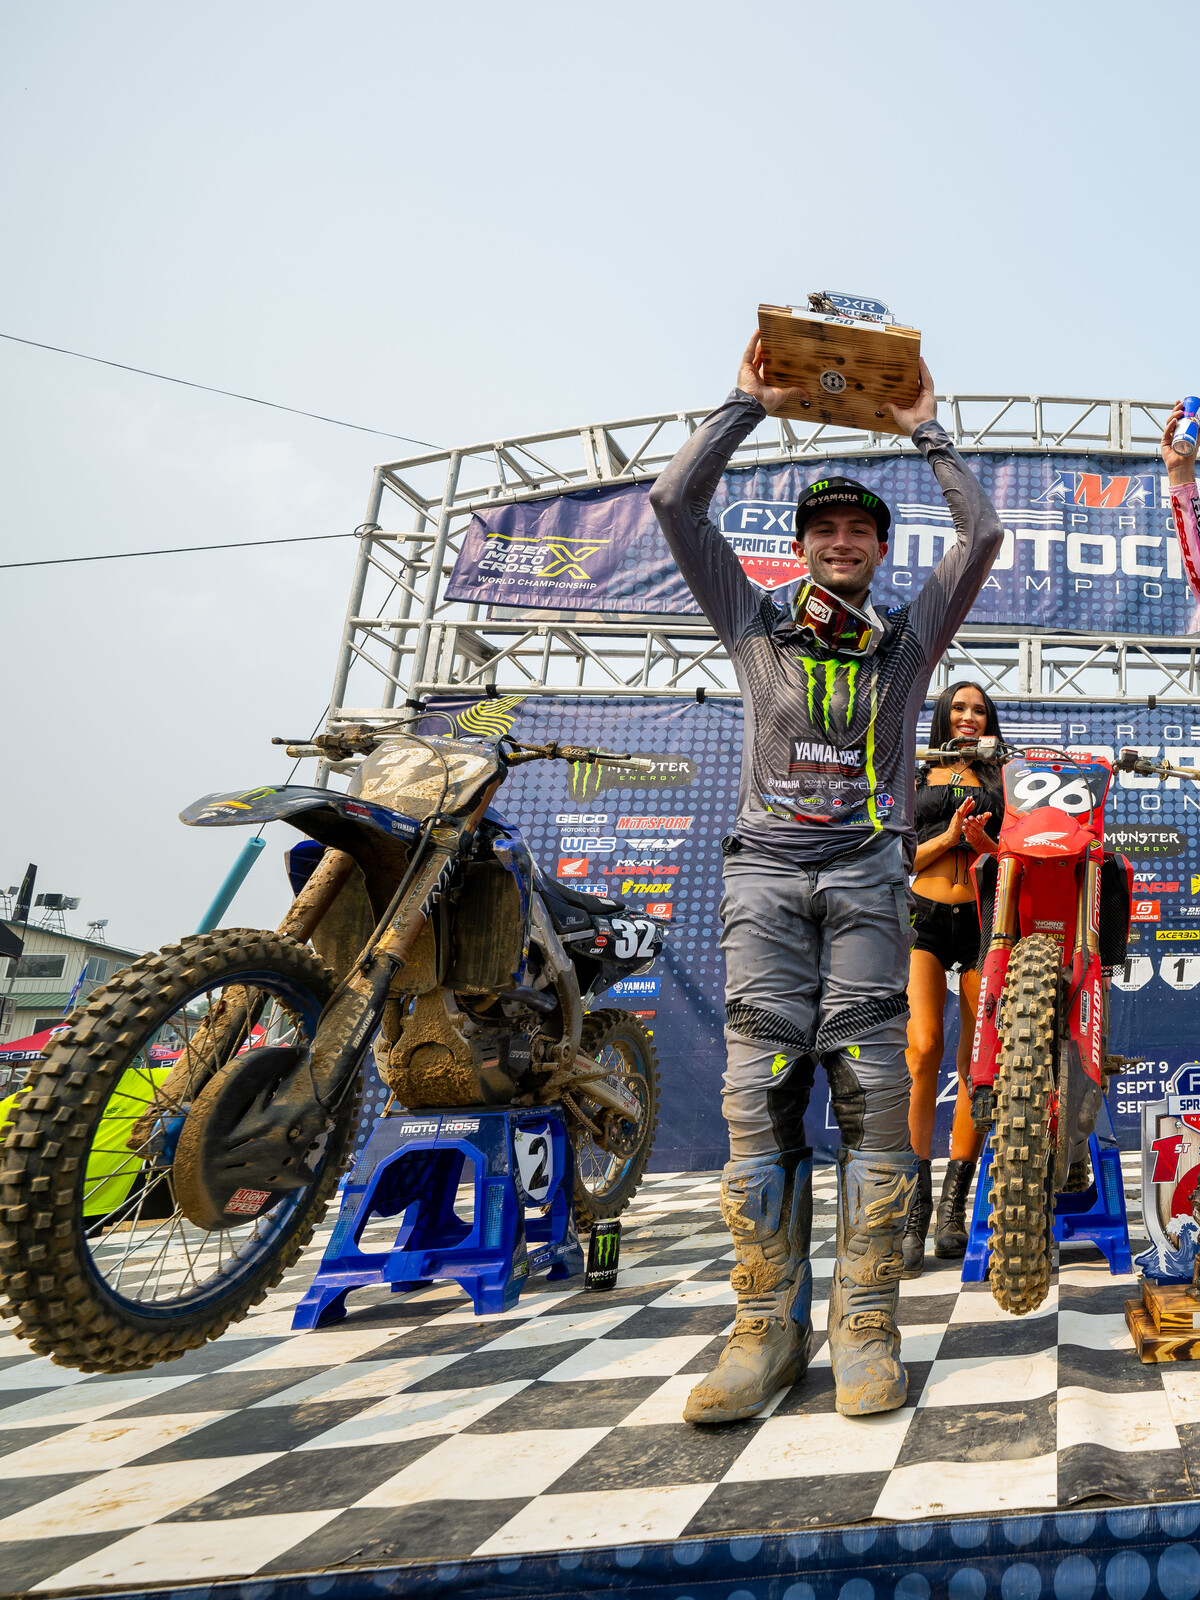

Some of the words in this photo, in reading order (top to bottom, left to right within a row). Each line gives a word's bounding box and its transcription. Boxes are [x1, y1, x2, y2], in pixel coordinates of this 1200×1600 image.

[824, 316, 855, 326] 250
[817, 493, 858, 501] YAMAHA
[1031, 471, 1156, 509] AMA
[741, 508, 796, 532] FX
[483, 540, 551, 555] SUPER
[484, 550, 545, 565] MOTO
[477, 559, 545, 575] CROSS
[477, 575, 515, 585] WORLD
[517, 578, 597, 590] CHAMPIONSHIP
[808, 600, 829, 618] 100%
[1069, 725, 1182, 741] PRO
[359, 747, 489, 803] 32
[1012, 772, 1097, 815] 96
[555, 814, 608, 824] GEICO
[560, 836, 617, 852] WPS
[1104, 831, 1180, 845] MONSTER
[1023, 841, 1069, 851] HONDA
[602, 866, 680, 877] LEGENDS
[567, 884, 608, 893] ARTS
[632, 883, 673, 894] THOR
[611, 918, 656, 959] 32
[623, 981, 656, 990] YAMAHA
[972, 976, 989, 1063] DUNLOP
[1091, 978, 1100, 1069] DUNLOP
[351, 1008, 376, 1050] BRAKING
[1158, 1061, 1168, 1073] 9
[1116, 1081, 1156, 1095] SEPT
[401, 1122, 480, 1134] MOTOCROSS
[527, 1136, 549, 1191] 2
[234, 1189, 270, 1202] LIGHT
[225, 1201, 262, 1213] SPEED
